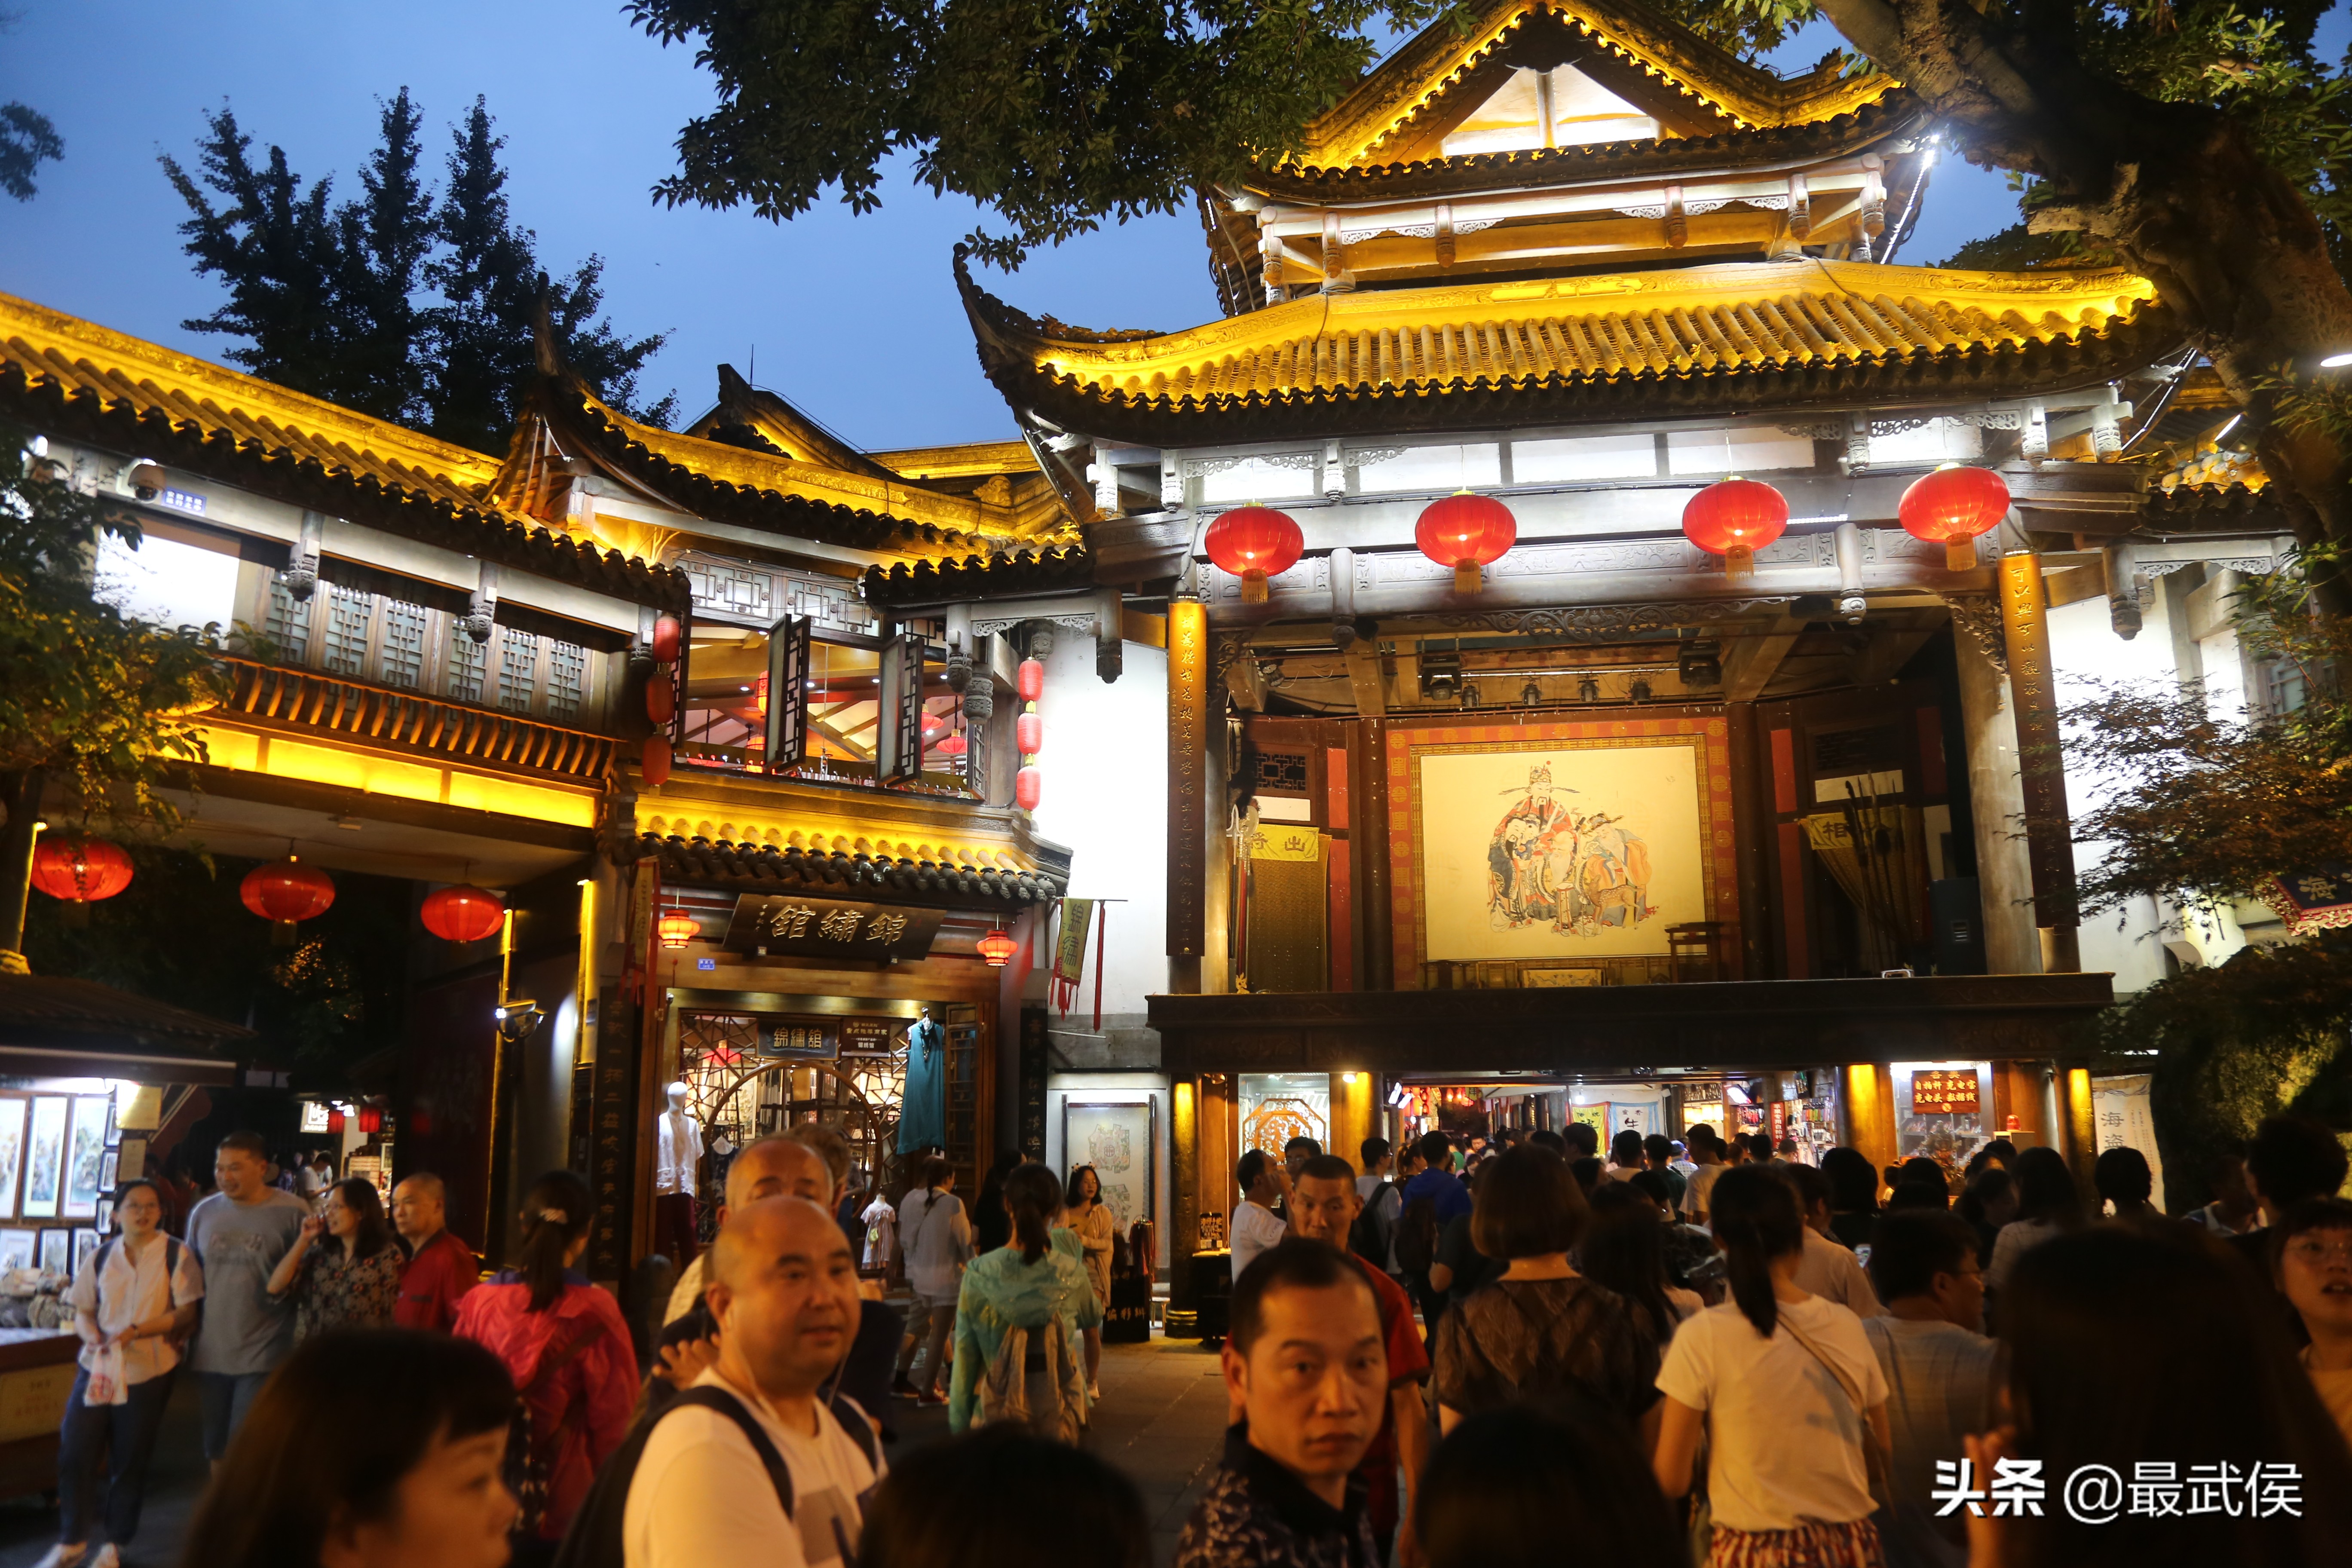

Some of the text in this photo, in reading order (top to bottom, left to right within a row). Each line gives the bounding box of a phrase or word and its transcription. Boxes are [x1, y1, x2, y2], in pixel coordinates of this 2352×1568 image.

[1930, 1071, 1960, 1079] 各类
[1915, 1079, 1976, 1090] 自拍杆 充电宝
[1915, 1092, 1976, 1103] 充电头 数据线
[1773, 1104, 1783, 1140] 苹果专用自拍杆
